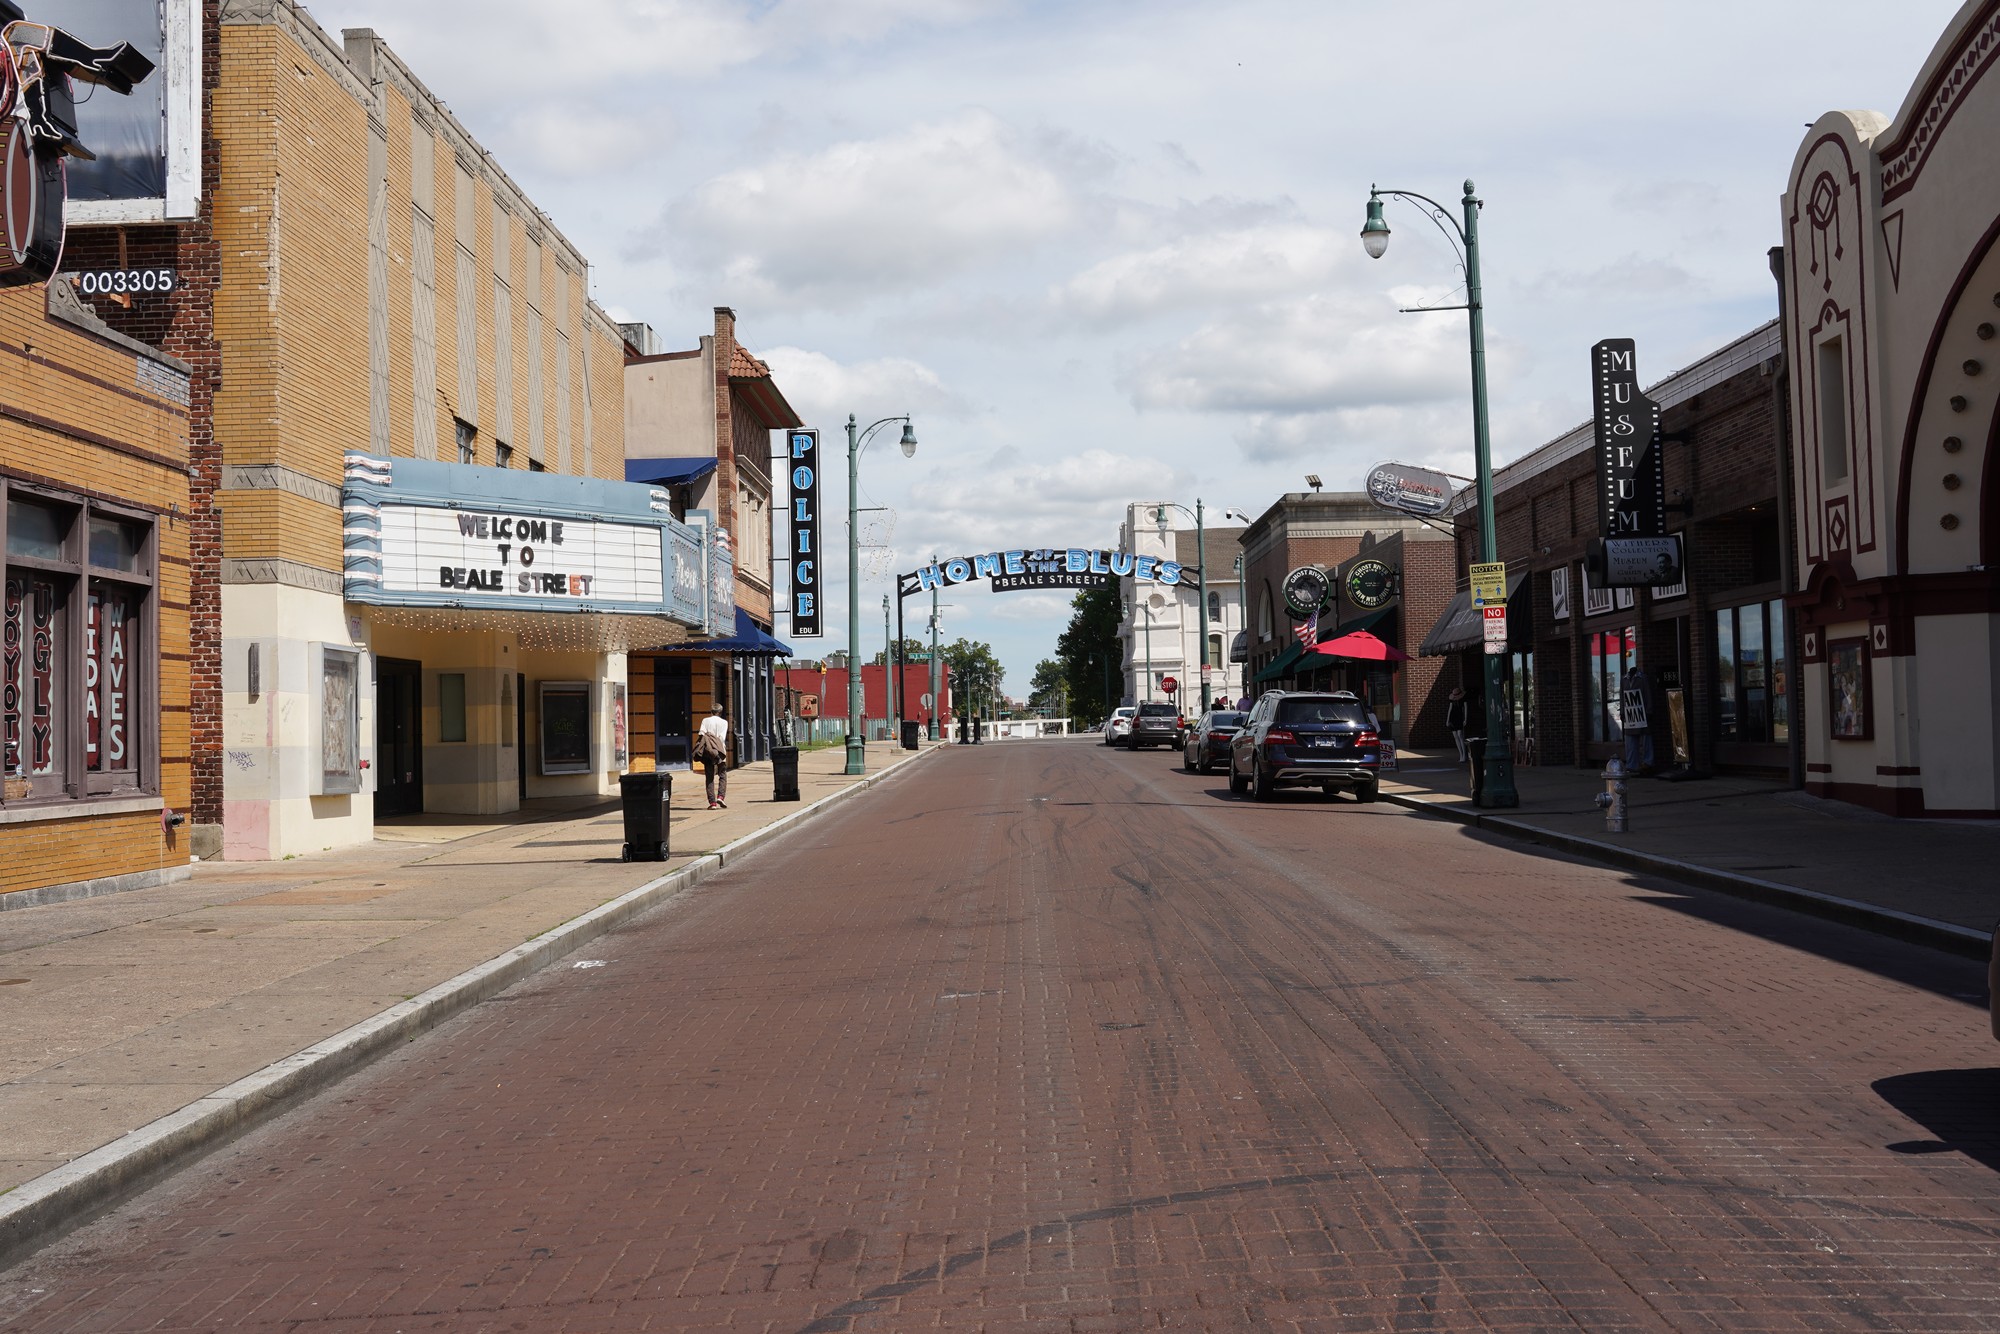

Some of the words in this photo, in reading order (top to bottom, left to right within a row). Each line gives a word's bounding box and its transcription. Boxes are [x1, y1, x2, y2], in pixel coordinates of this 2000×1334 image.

[82, 270, 173, 294] 003305
[1609, 350, 1640, 533] MUSEUM
[457, 513, 564, 546] WELCOME
[792, 434, 814, 617] POLICE
[1611, 546, 1669, 554] COLLECTION
[1612, 539, 1669, 548] WITHERS
[1032, 548, 1054, 561] OF
[1613, 557, 1647, 565] MUSEUM
[917, 549, 1026, 592] HOME
[1027, 560, 1060, 573] THE
[1065, 547, 1183, 585] BLUES
[1472, 565, 1502, 573] NOTICE
[440, 566, 504, 593] BEALE
[518, 571, 594, 596] STREET
[1001, 575, 1044, 587] BEALE
[1049, 574, 1099, 585] STREET
[1290, 569, 1308, 584] GHOST
[1308, 569, 1325, 583] RIVER
[1487, 608, 1502, 617] NO
[4, 579, 21, 772] COYOTE
[32, 586, 50, 764] UGLY
[86, 596, 98, 753] TIDAL
[110, 602, 126, 761] WAVES
[1162, 681, 1177, 689] STOP
[1626, 707, 1645, 723] MAN
